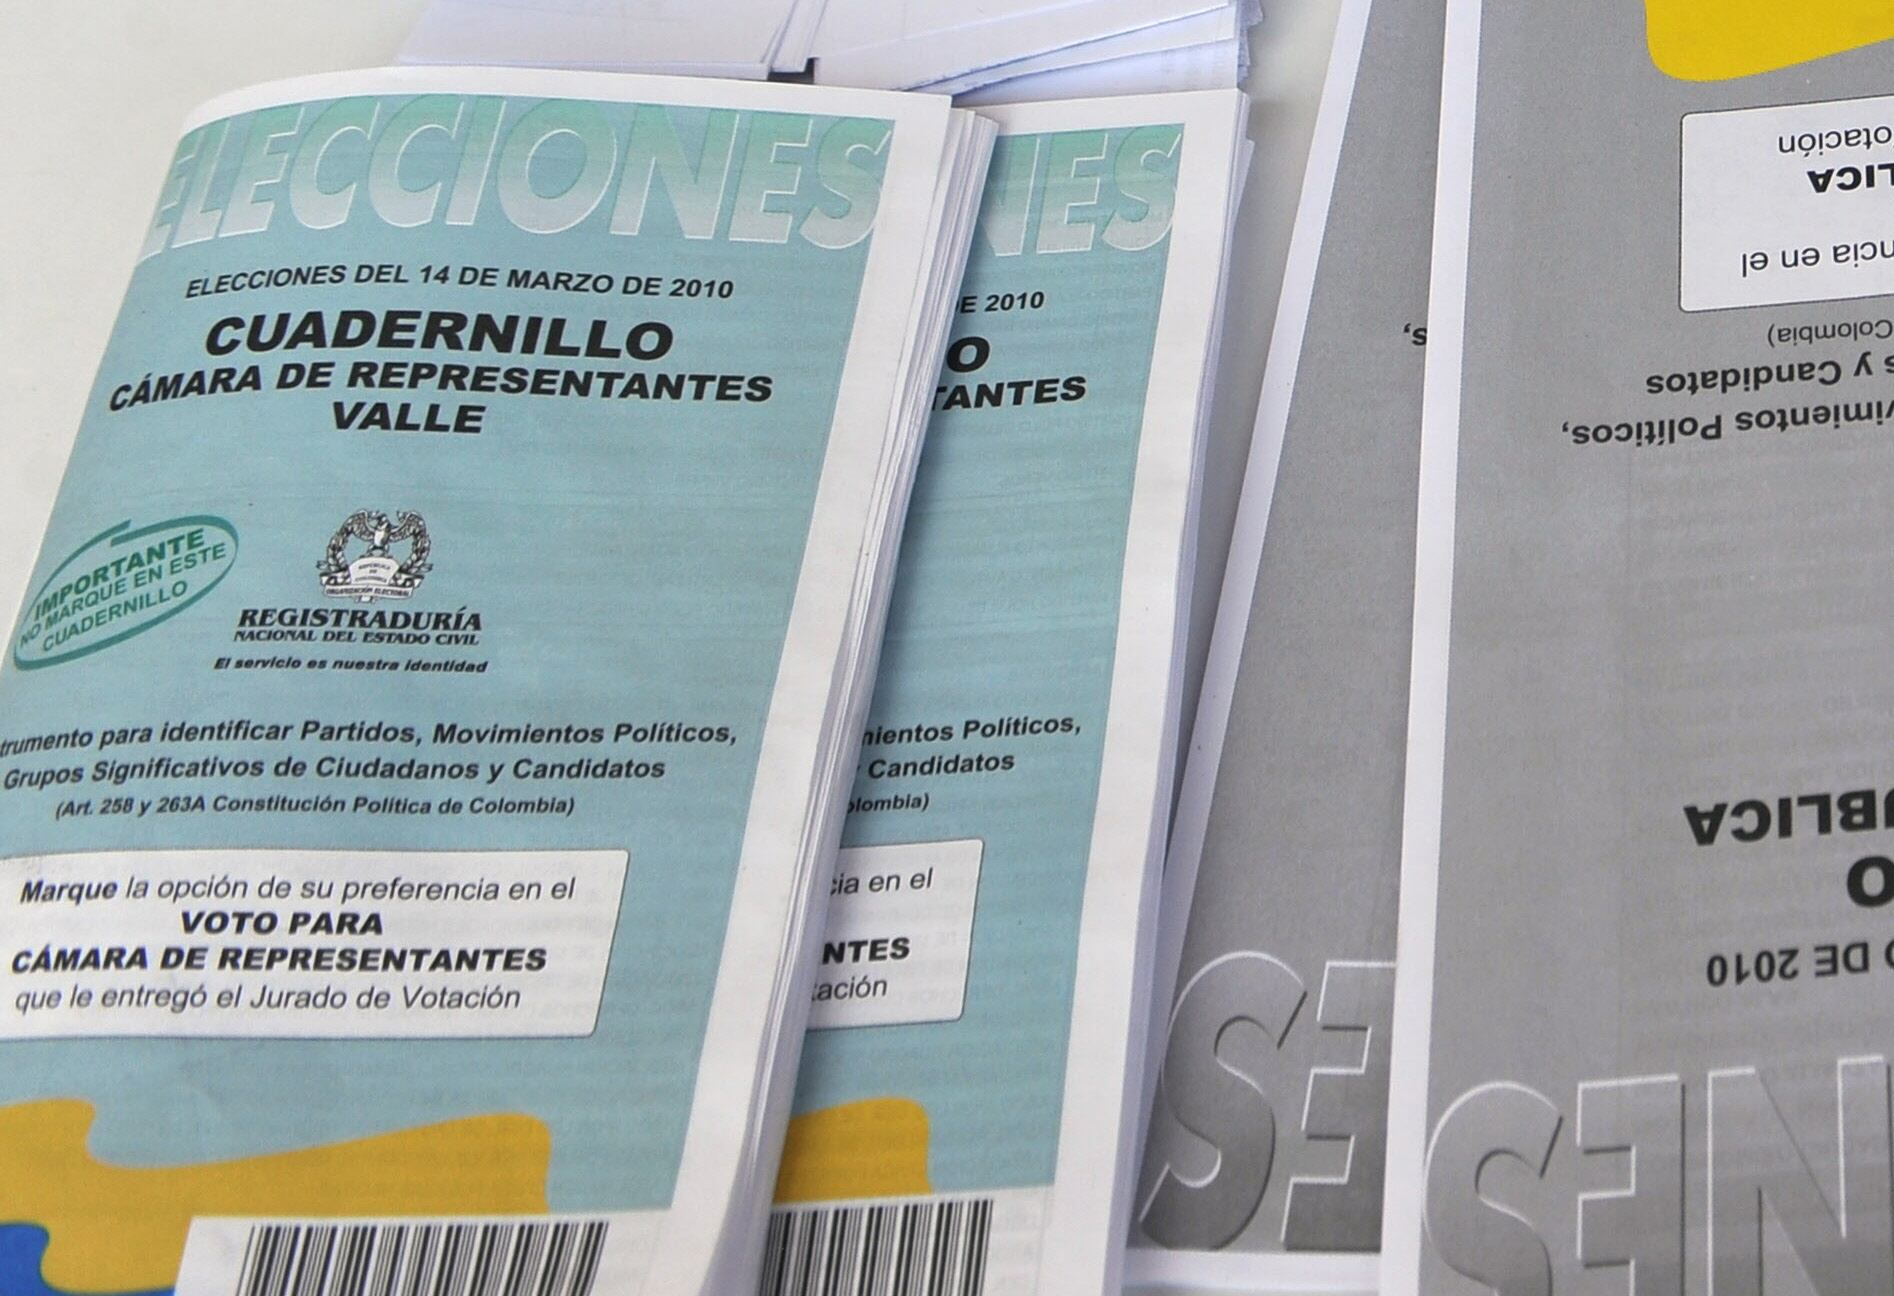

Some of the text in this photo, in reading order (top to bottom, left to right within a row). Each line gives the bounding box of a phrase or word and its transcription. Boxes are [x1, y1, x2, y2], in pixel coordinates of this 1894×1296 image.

[138, 93, 893, 256] ELECCIONES
[204, 308, 674, 361] CUADERNILLO
[1766, 318, 1894, 349] Colombia)
[1644, 359, 1842, 396] Candidatos
[1852, 349, 1873, 377] y
[108, 360, 773, 412] CÁMARA DE REPRESENTANTES
[331, 400, 487, 434] VALLE
[1561, 413, 1722, 446] Políticos,
[33, 526, 205, 622] IMPORTANTE
[236, 606, 482, 632] REGISTRADURÍA
[961, 714, 1081, 740] Políticos,
[867, 752, 1015, 779] Candidatos
[180, 910, 383, 935] VOTO PARA
[11, 943, 547, 974] CÁMARA DE REPRESENTANTES
[1705, 946, 1800, 987] 2010
[1812, 940, 1870, 978] DE
